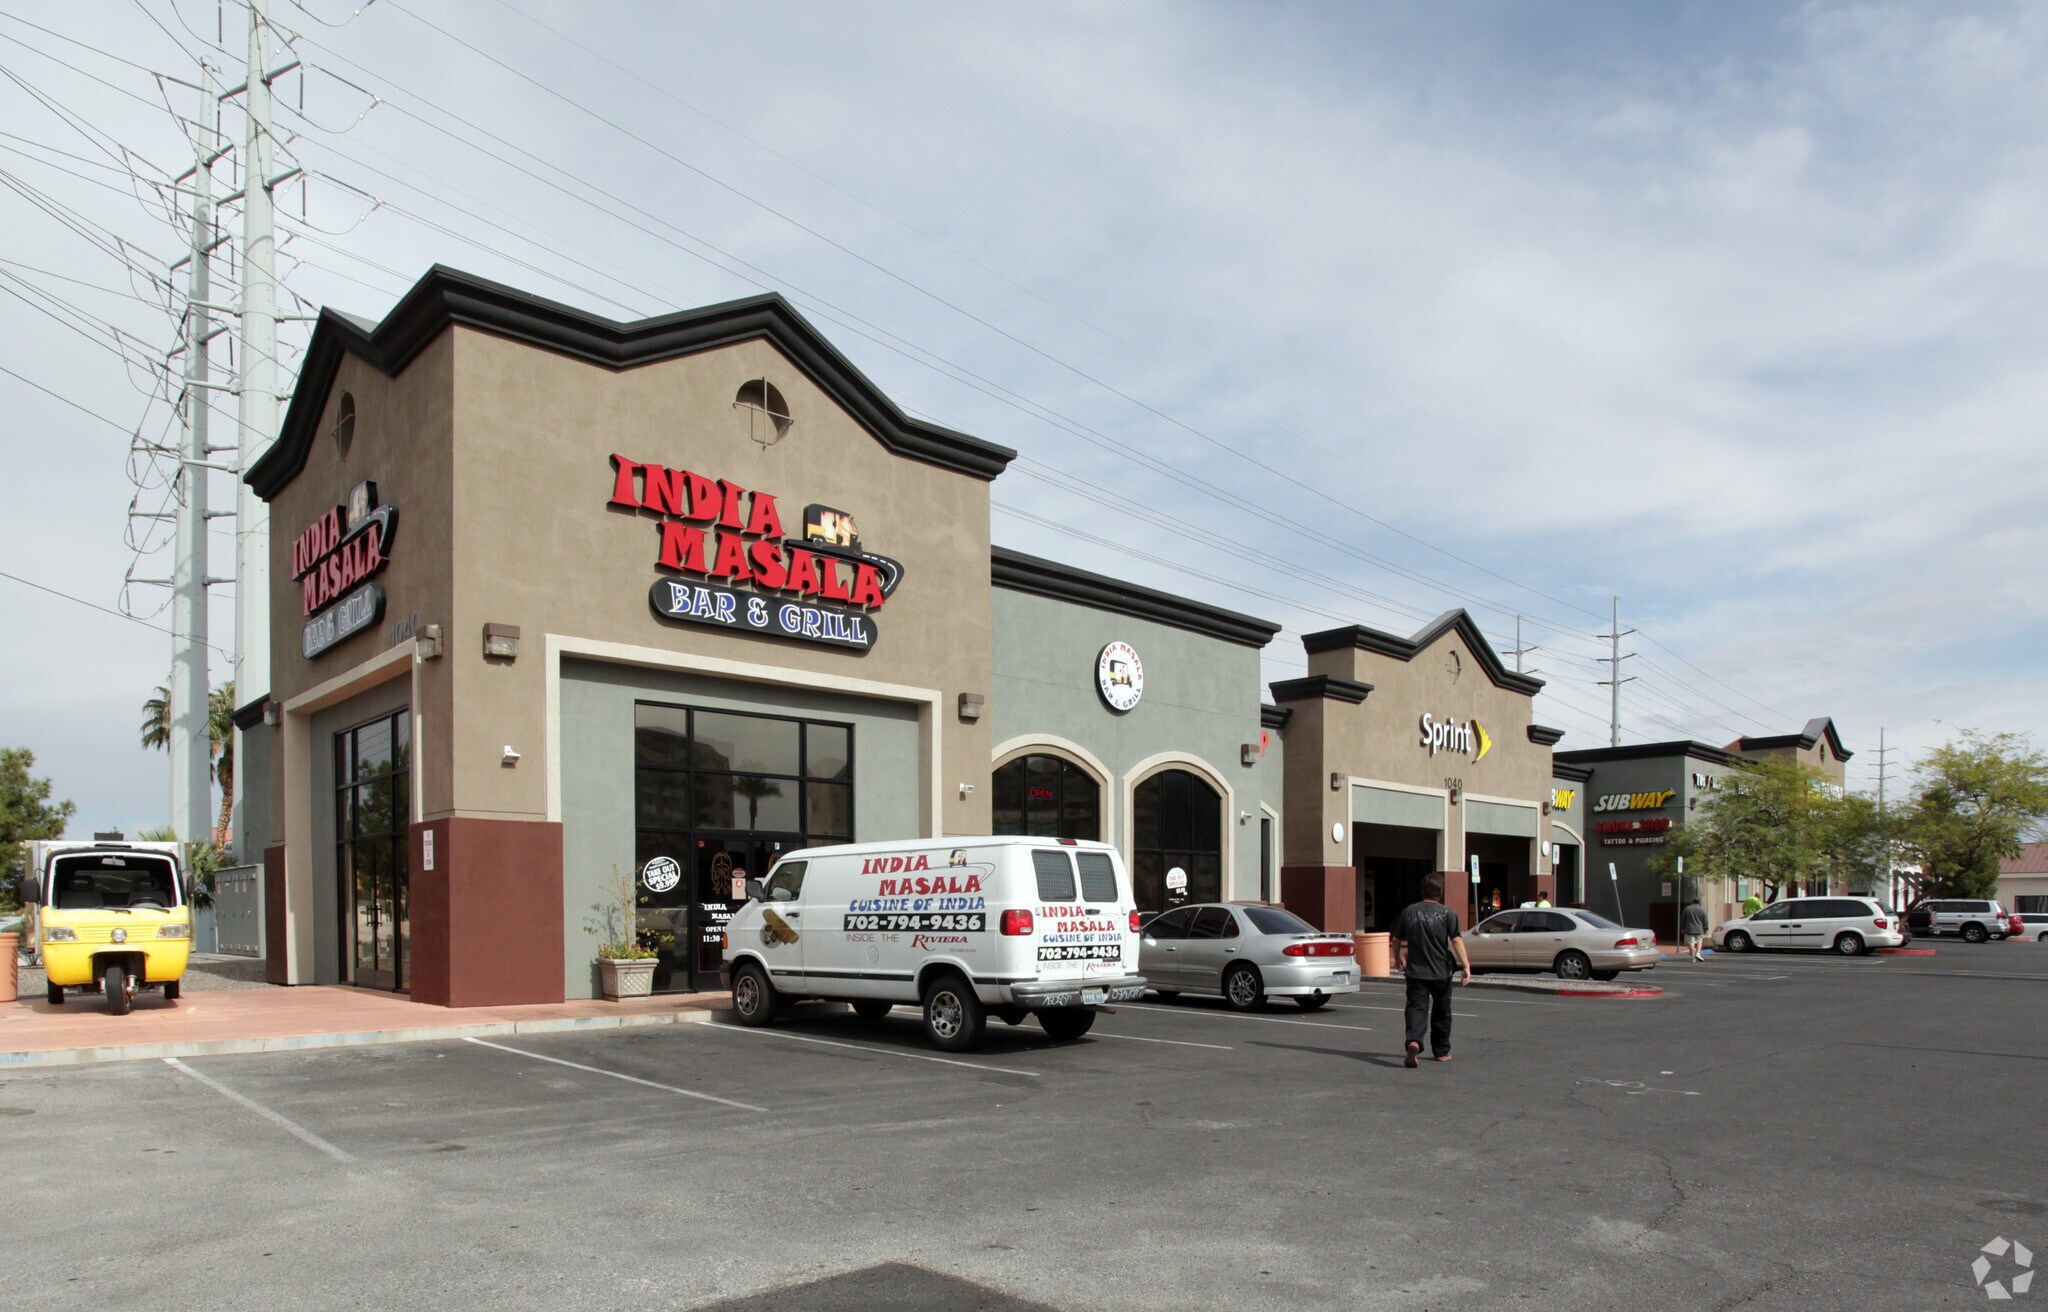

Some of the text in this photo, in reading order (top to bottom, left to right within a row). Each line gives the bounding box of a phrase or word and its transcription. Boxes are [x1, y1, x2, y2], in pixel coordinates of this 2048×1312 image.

[612, 453, 786, 538] INDIA
[291, 504, 341, 581] INDIA
[303, 523, 383, 617] MASALA
[656, 521, 886, 608] MASALA
[304, 619, 326, 655] BAR
[338, 589, 373, 635] GRILL
[667, 581, 869, 646] BAR & GRILL
[1101, 643, 1143, 681] INDIA MASALA
[1101, 679, 1114, 700] BAR
[1122, 687, 1142, 708] GRILL
[1422, 712, 1472, 755] Sprint
[1028, 787, 1054, 799] OPEN
[1444, 777, 1463, 791] 1040
[1551, 788, 1576, 809] BWAY
[1593, 787, 1676, 813] SUBWAY
[646, 868, 661, 878] TAKE
[661, 863, 675, 873] OUT
[861, 855, 931, 875] INDIA
[648, 871, 677, 886] SPECIAL
[878, 875, 982, 896] MASALA
[703, 903, 728, 911] INDIA
[849, 896, 986, 912] CUISINE OF INDIA
[1042, 906, 1085, 918] INDIA
[847, 915, 981, 931] 702-794-9436
[1057, 920, 1115, 933] MASALA
[846, 934, 875, 942] INSIDE
[881, 934, 899, 943] THE
[910, 934, 968, 952] RIVIERA
[1042, 933, 1122, 943] CUISINE OF INDIA
[1039, 946, 1119, 960] 702-794-9436
[1042, 961, 1116, 973] INSIDE THE RIVIERA
